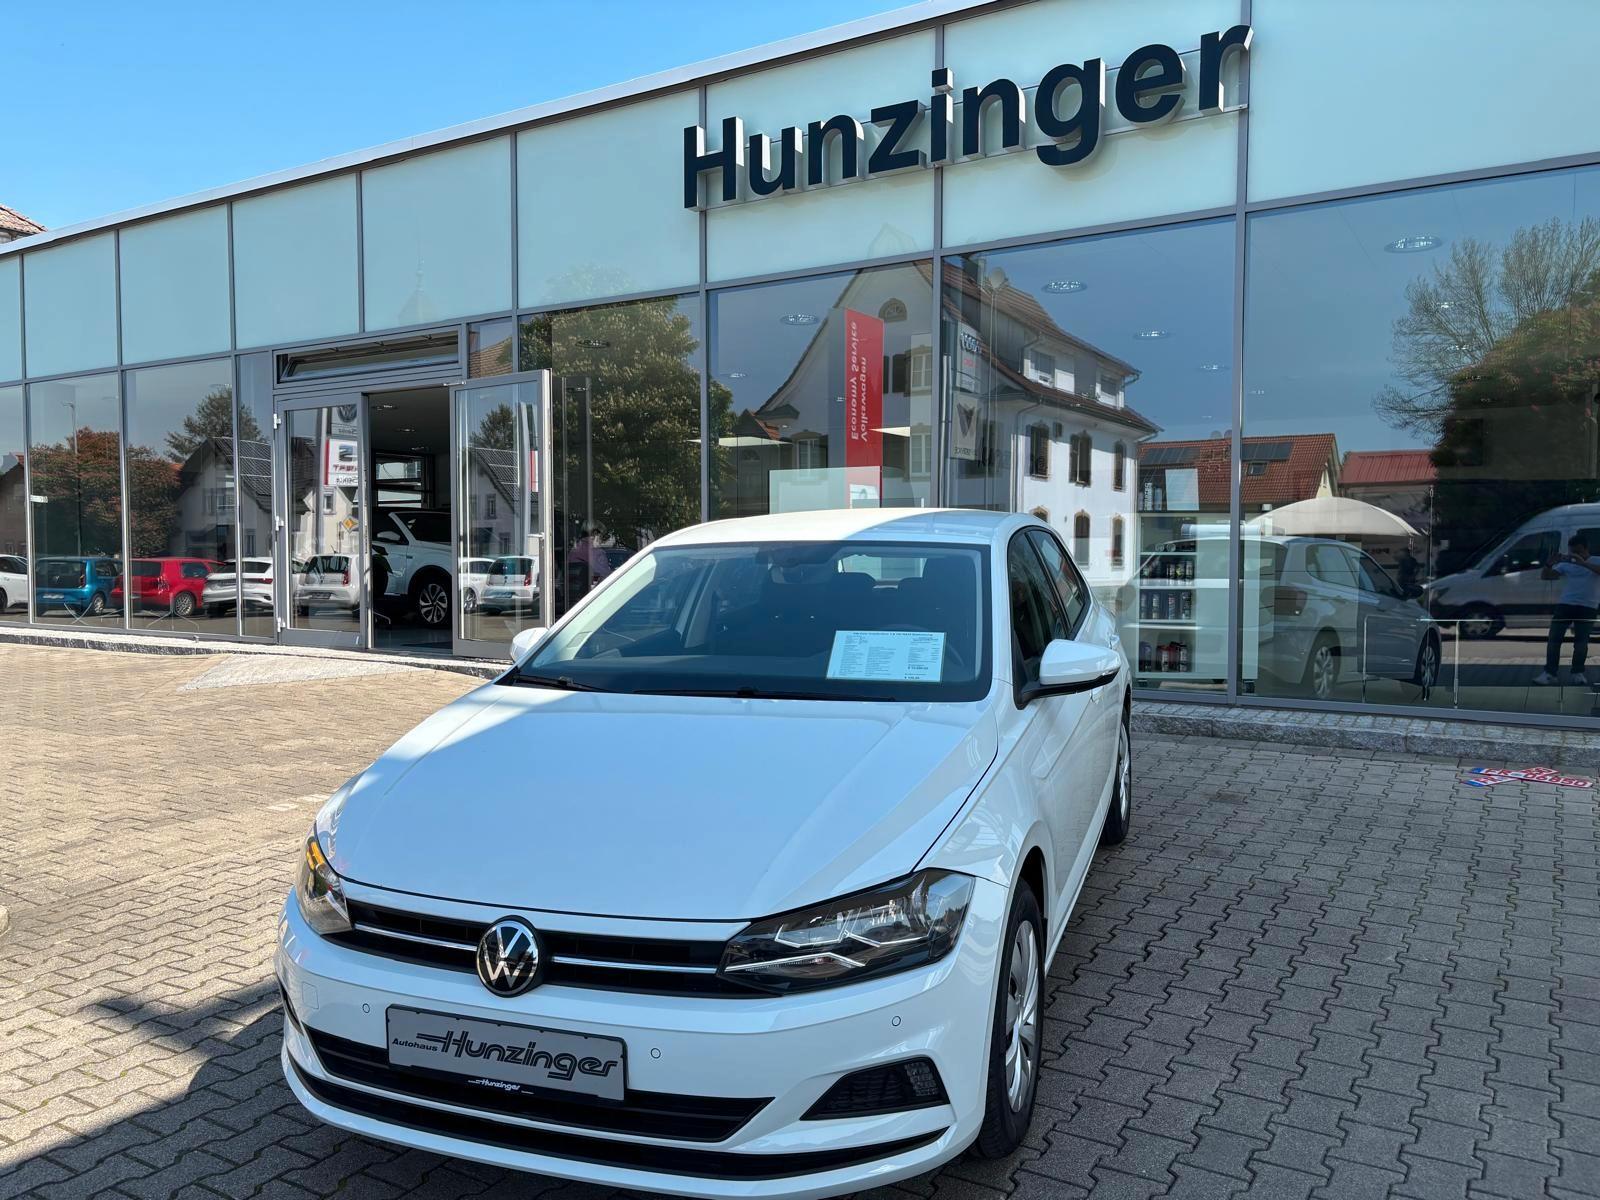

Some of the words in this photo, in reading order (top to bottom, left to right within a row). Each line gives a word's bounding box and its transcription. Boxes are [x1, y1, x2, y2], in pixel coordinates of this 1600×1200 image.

[683, 24, 1254, 212] Hunzinger
[392, 1037, 438, 1052] Autohaus
[417, 1030, 618, 1081] Hunzinger
[476, 1079, 521, 1091] Hunzinger
